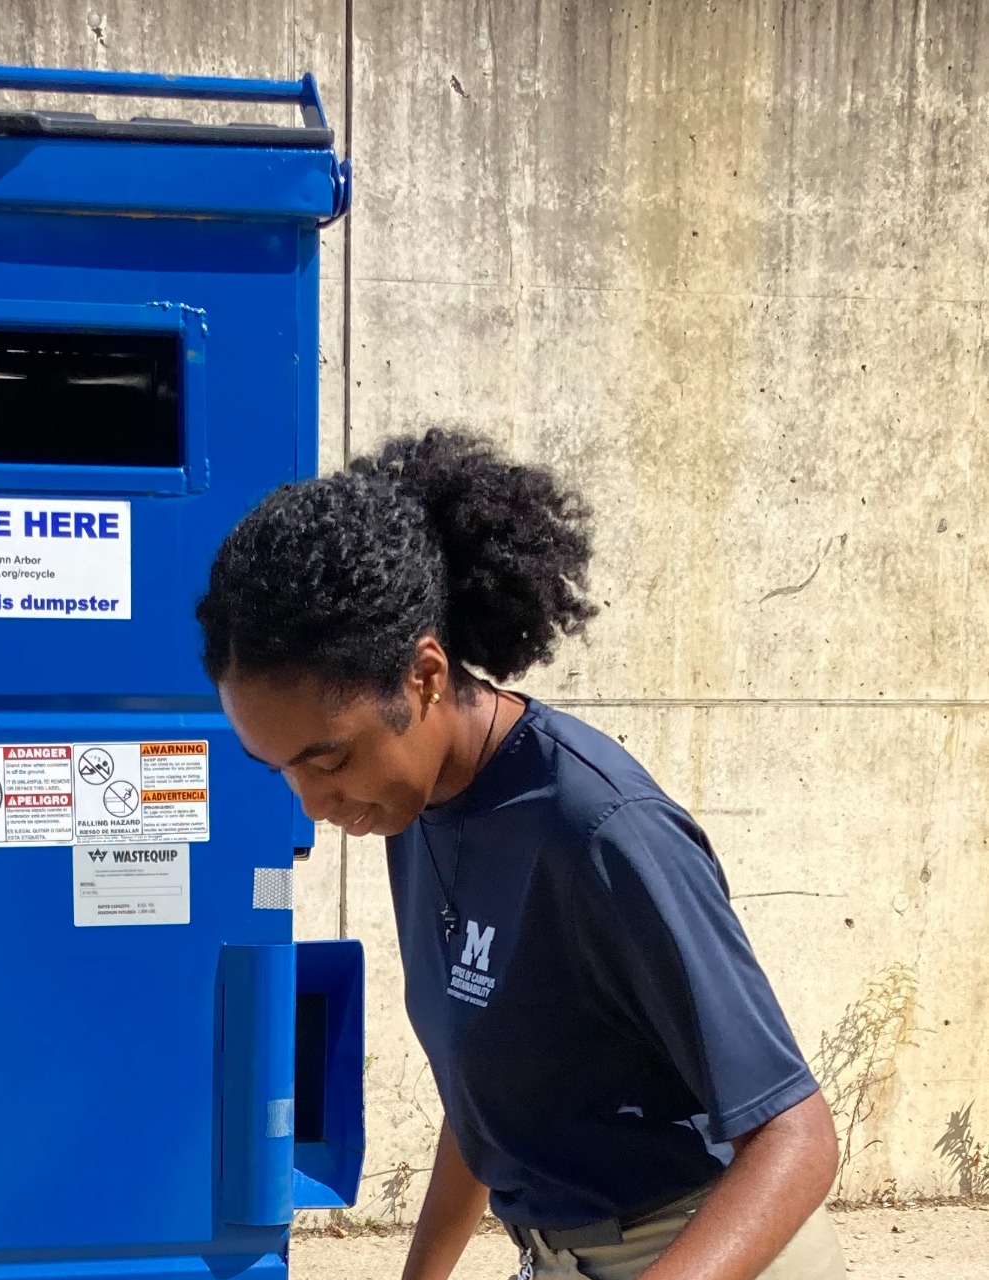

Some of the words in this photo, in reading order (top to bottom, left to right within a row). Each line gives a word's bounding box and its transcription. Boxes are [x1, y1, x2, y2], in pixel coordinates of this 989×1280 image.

[24, 511, 119, 539] HERE
[14, 556, 42, 565] Arbor
[20, 594, 120, 615] dumpster
[17, 748, 67, 758] DANGER
[150, 745, 204, 754] WARNING
[17, 795, 69, 806] PELIGRO
[152, 791, 205, 801] ADVERTENCIA
[112, 850, 178, 863] WASTEQUIP
[460, 919, 496, 972] M
[471, 972, 495, 989] CAMPUS
